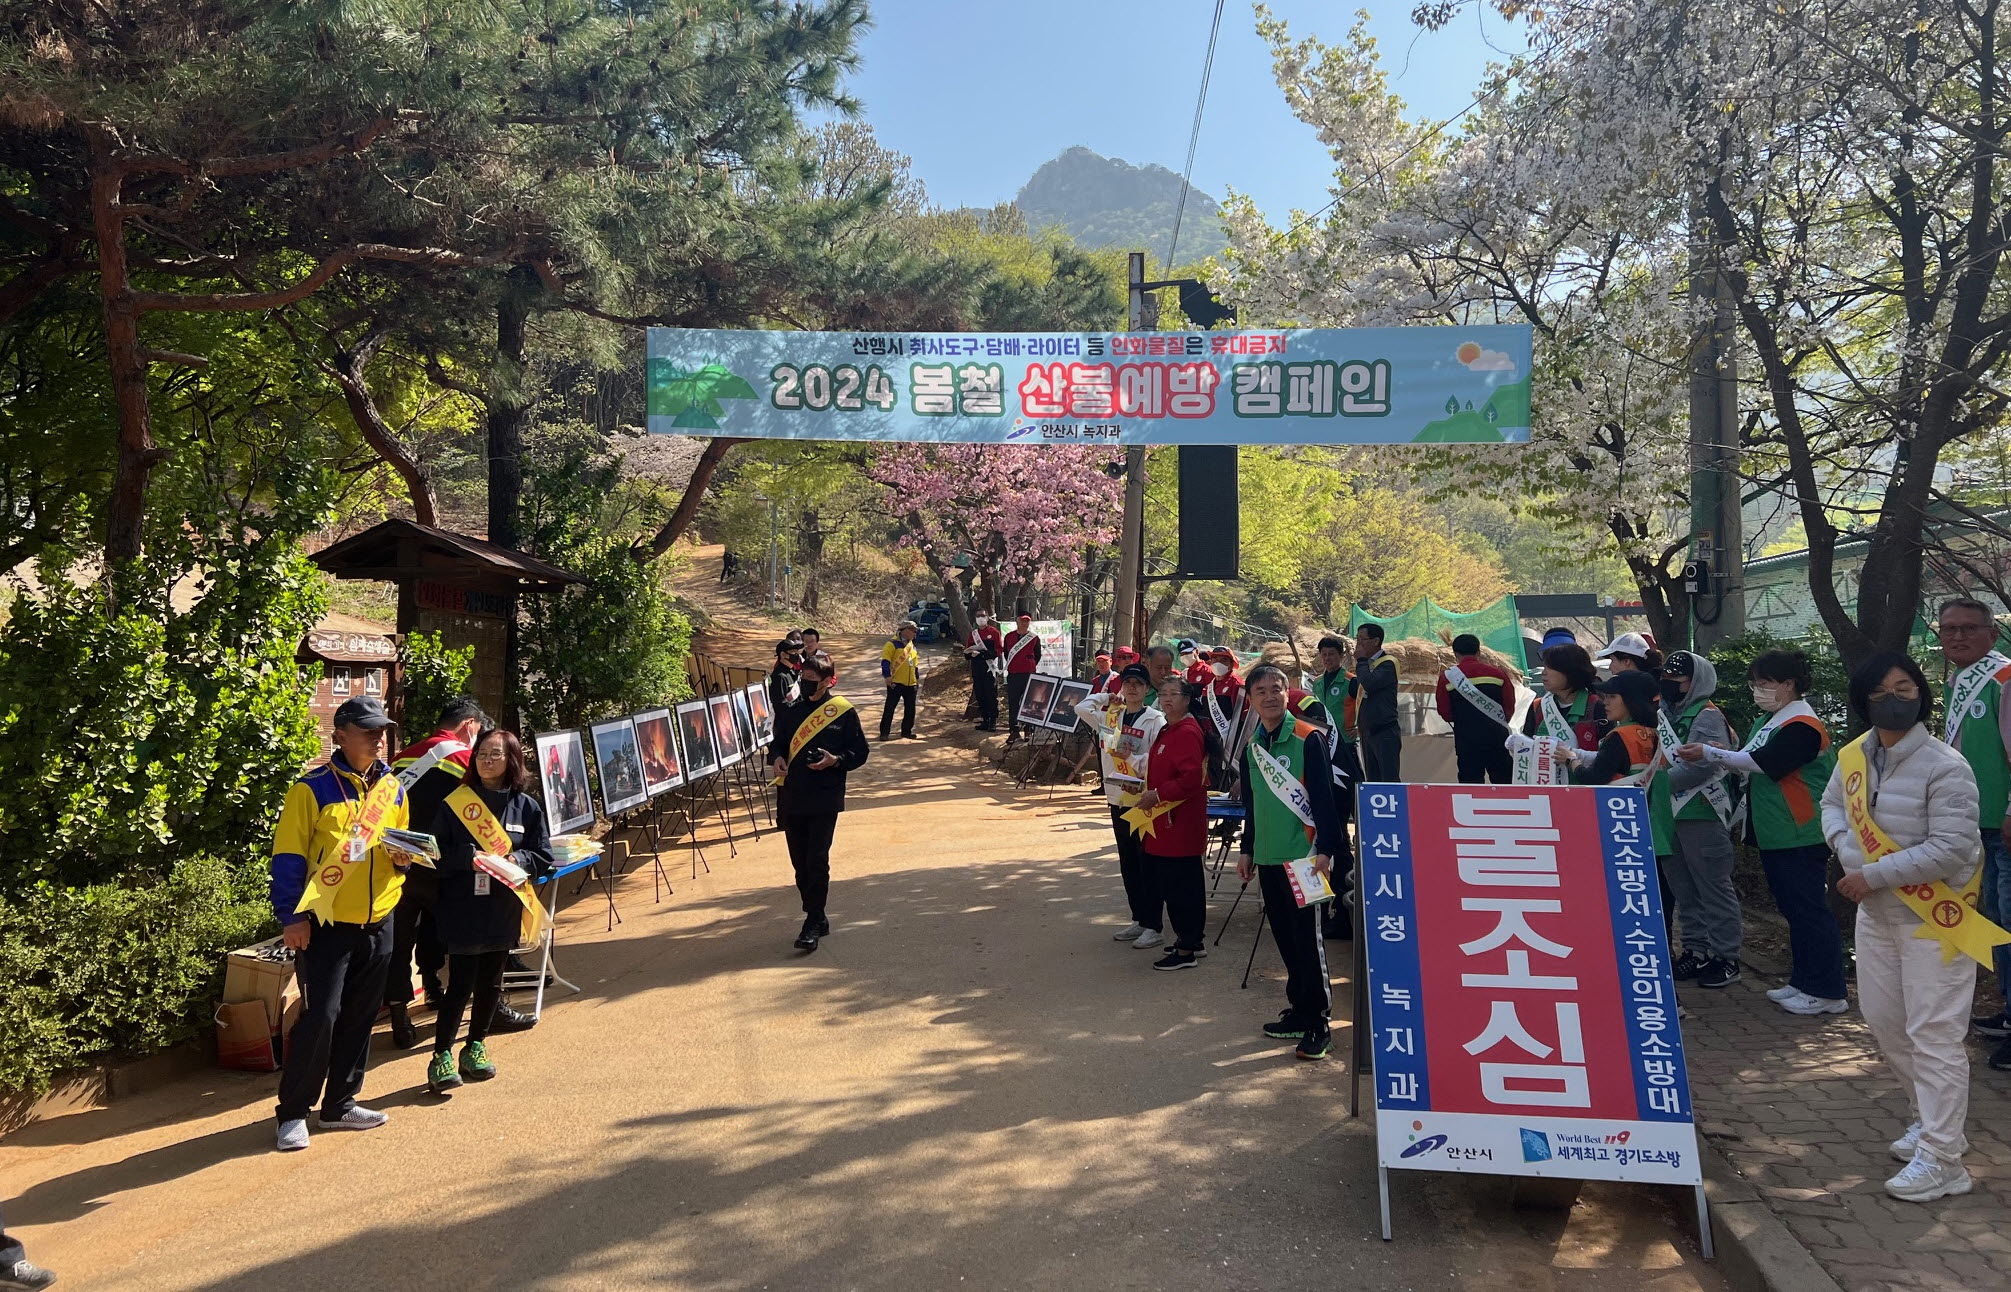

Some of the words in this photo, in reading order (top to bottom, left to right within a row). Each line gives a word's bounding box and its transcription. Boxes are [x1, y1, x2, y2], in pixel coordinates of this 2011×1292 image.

[852, 337, 904, 356] 산행시
[909, 337, 1080, 356] 취사도구·담배·라이터
[1087, 337, 1104, 356] 등
[1111, 336, 1203, 356] 인화물질은
[1210, 335, 1286, 355] 휴대금지
[771, 364, 896, 411] 2024
[911, 363, 1003, 415] 봄철
[1020, 363, 1219, 417] 산불예방
[1233, 360, 1390, 417] 캠페인
[1041, 424, 1078, 439] 안산시
[1083, 424, 1121, 439] 녹지과
[1952, 659, 1997, 718] 산지정화
[1369, 793, 1406, 942] 안산시청
[1448, 793, 1591, 1108] 불조심
[1607, 796, 1680, 1114] 안산소방서·수암의용소방대
[1381, 983, 1419, 1102] 녹지과
[1446, 1147, 1493, 1161] 안산시
[1556, 1133, 1582, 1144] World
[1584, 1134, 1601, 1144] Best
[1604, 1130, 1631, 1145] 119
[1557, 1146, 1610, 1162] 세계최고
[1615, 1148, 1681, 1169] 경기도소방
